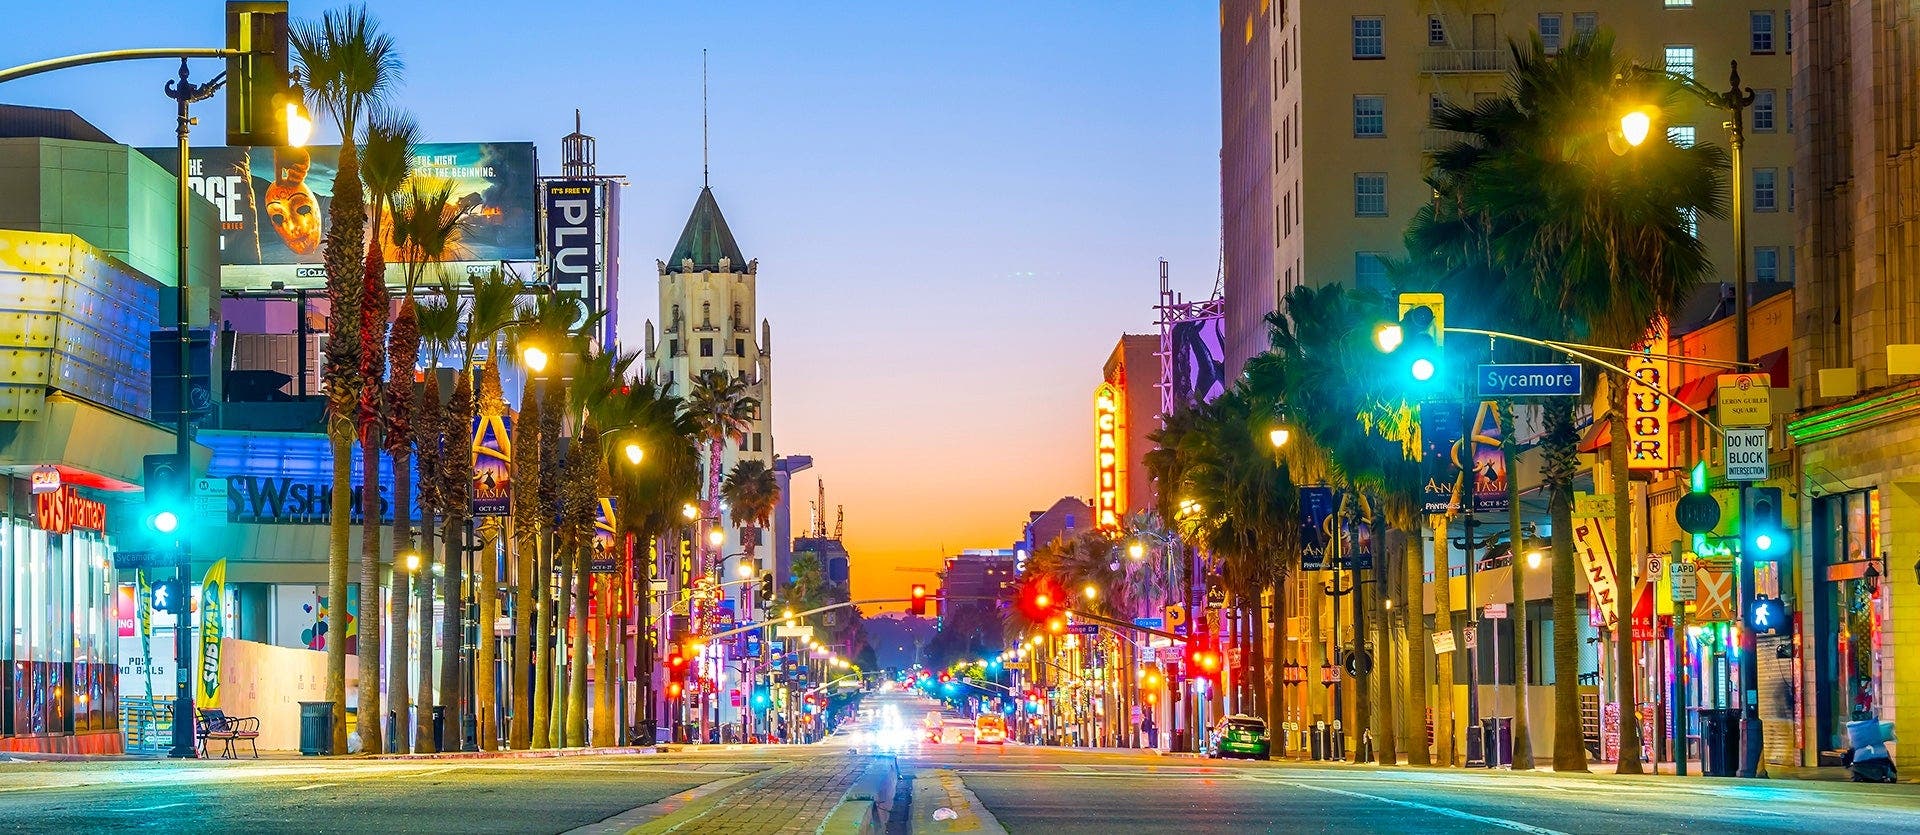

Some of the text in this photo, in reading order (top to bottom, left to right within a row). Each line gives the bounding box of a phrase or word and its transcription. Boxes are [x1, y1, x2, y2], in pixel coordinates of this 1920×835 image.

[434, 154, 458, 166] NIGHT
[188, 159, 203, 176] HE
[435, 167, 449, 178] THE
[452, 166, 497, 178] BEGINNING.
[222, 222, 244, 231] ERIES
[1487, 371, 1573, 391] Sycamore
[1727, 435, 1764, 447] DO NOT
[1729, 451, 1763, 464] BLOCK
[1099, 414, 1117, 526] CAPITA
[1728, 466, 1765, 475] INTERSECTION
[1575, 525, 1619, 626] PIZZA
[1671, 565, 1694, 574] LAPD
[1067, 626, 1087, 634] range
[203, 589, 220, 691] SUBWAY
